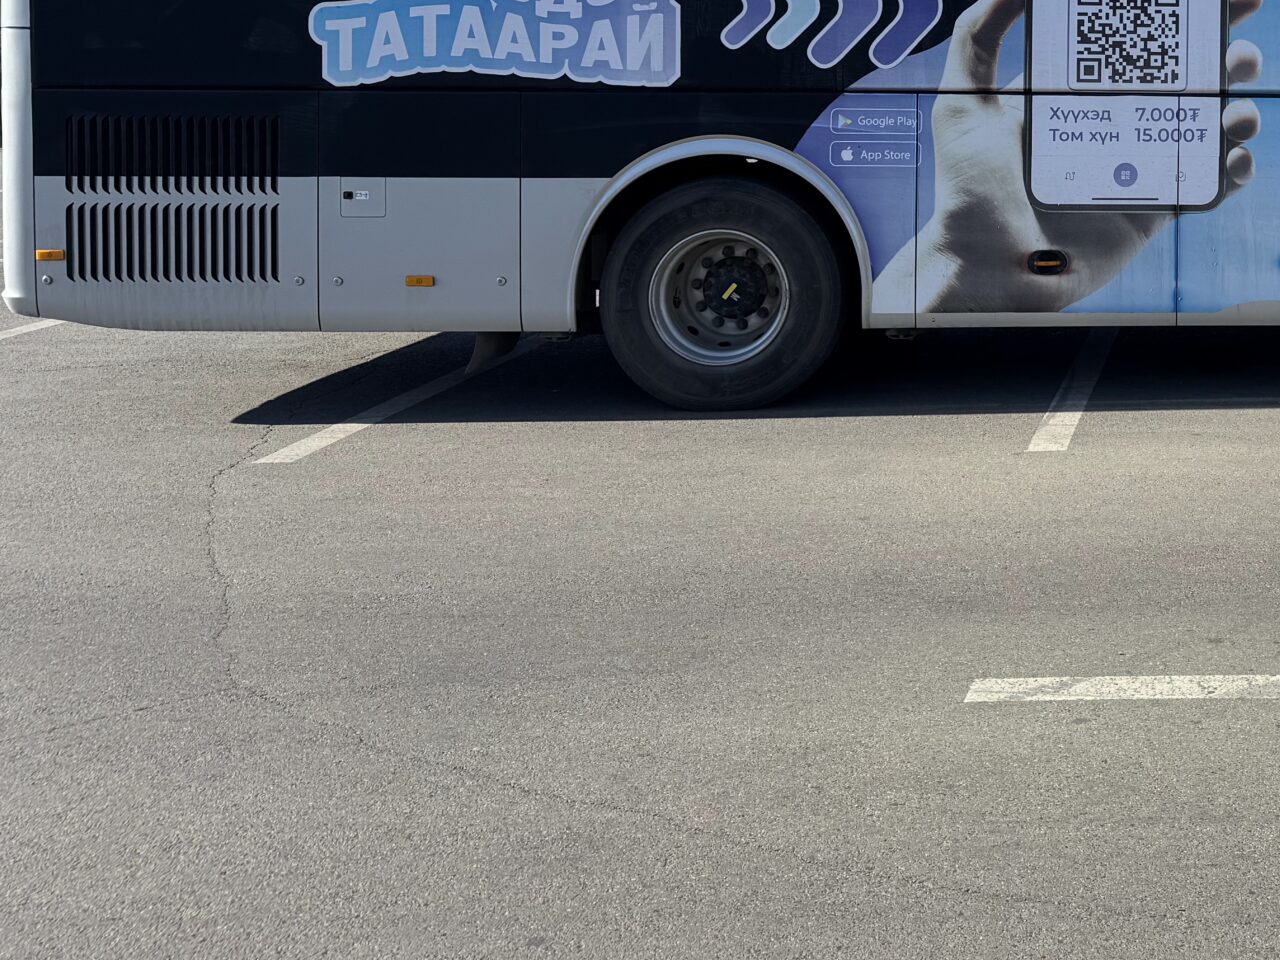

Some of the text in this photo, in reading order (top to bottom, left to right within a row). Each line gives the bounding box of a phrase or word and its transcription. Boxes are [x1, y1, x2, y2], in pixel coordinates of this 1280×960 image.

[324, 1, 665, 72] ТАТААРАЙ
[857, 115, 917, 129] Google Play
[1049, 106, 1112, 124] Хүүхэд
[1049, 128, 1083, 143] Том
[1089, 131, 1120, 146] хүн
[860, 149, 911, 162] App Store
